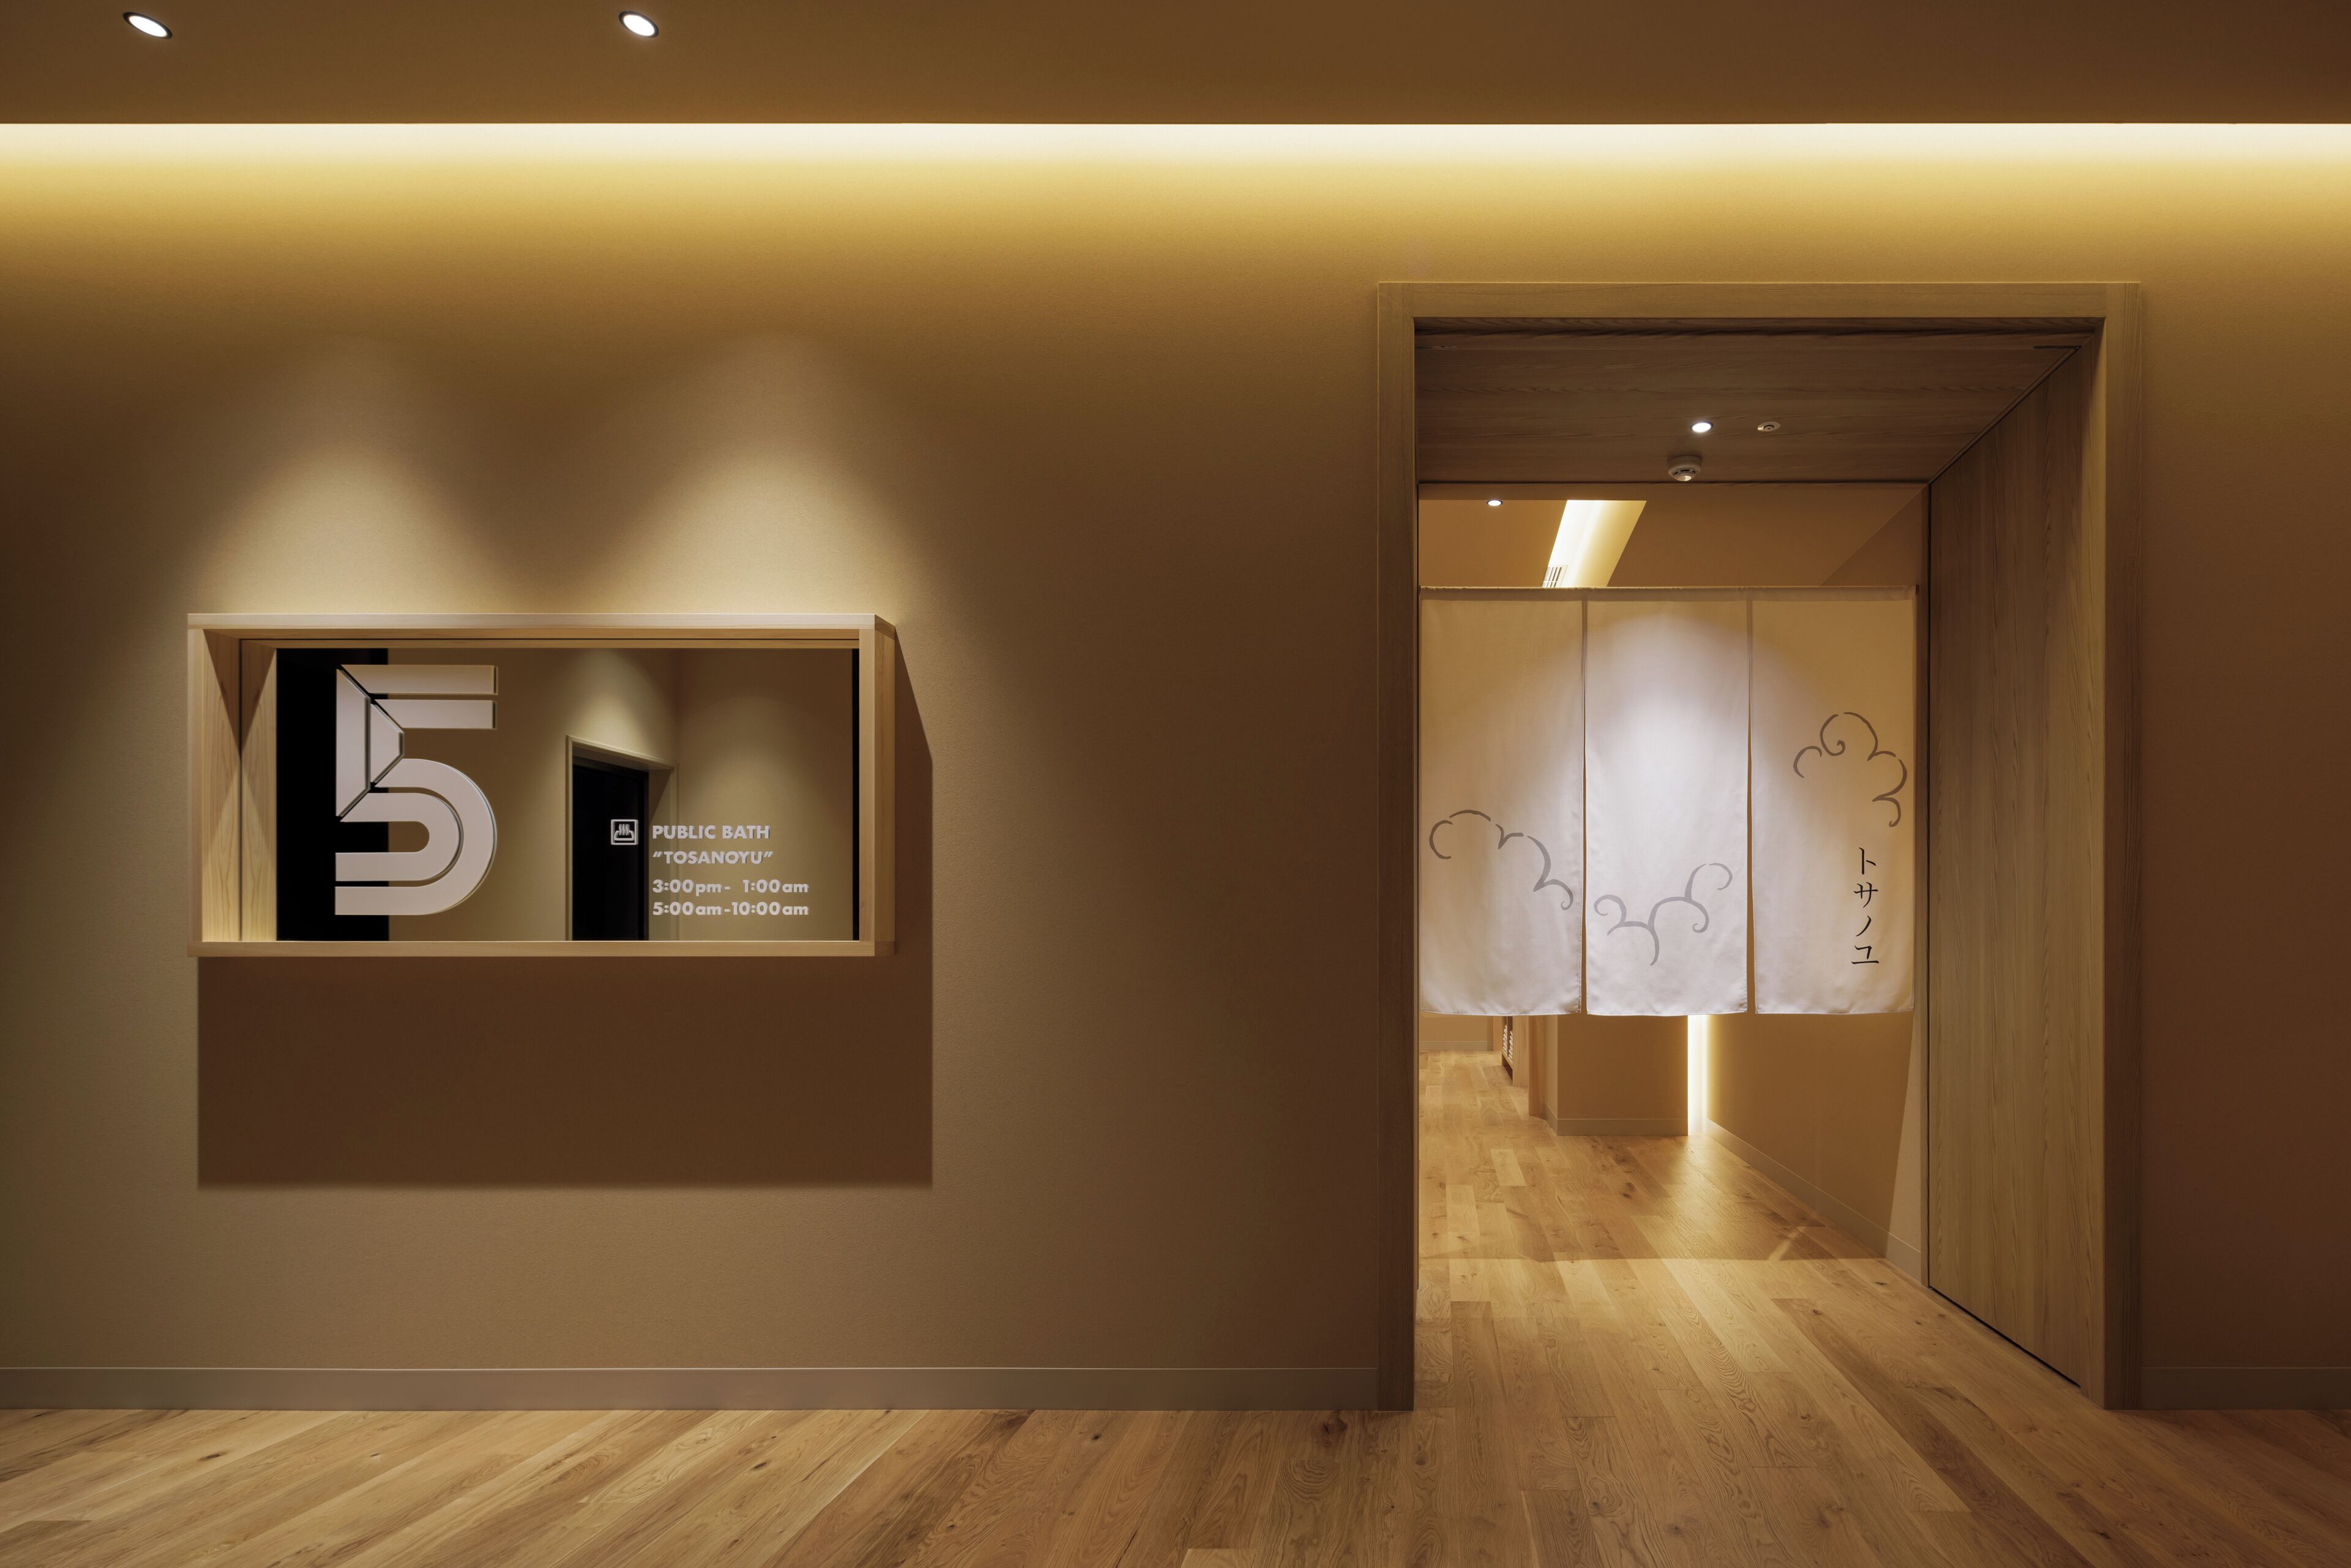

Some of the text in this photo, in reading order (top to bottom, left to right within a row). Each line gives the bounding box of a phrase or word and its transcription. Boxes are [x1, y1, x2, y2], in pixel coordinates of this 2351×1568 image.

[335, 664, 498, 916] 5
[652, 825, 770, 839] PUBLIC BATH
[743, 879, 809, 893] 1:00am
[1851, 847, 1880, 965] トサノユ
